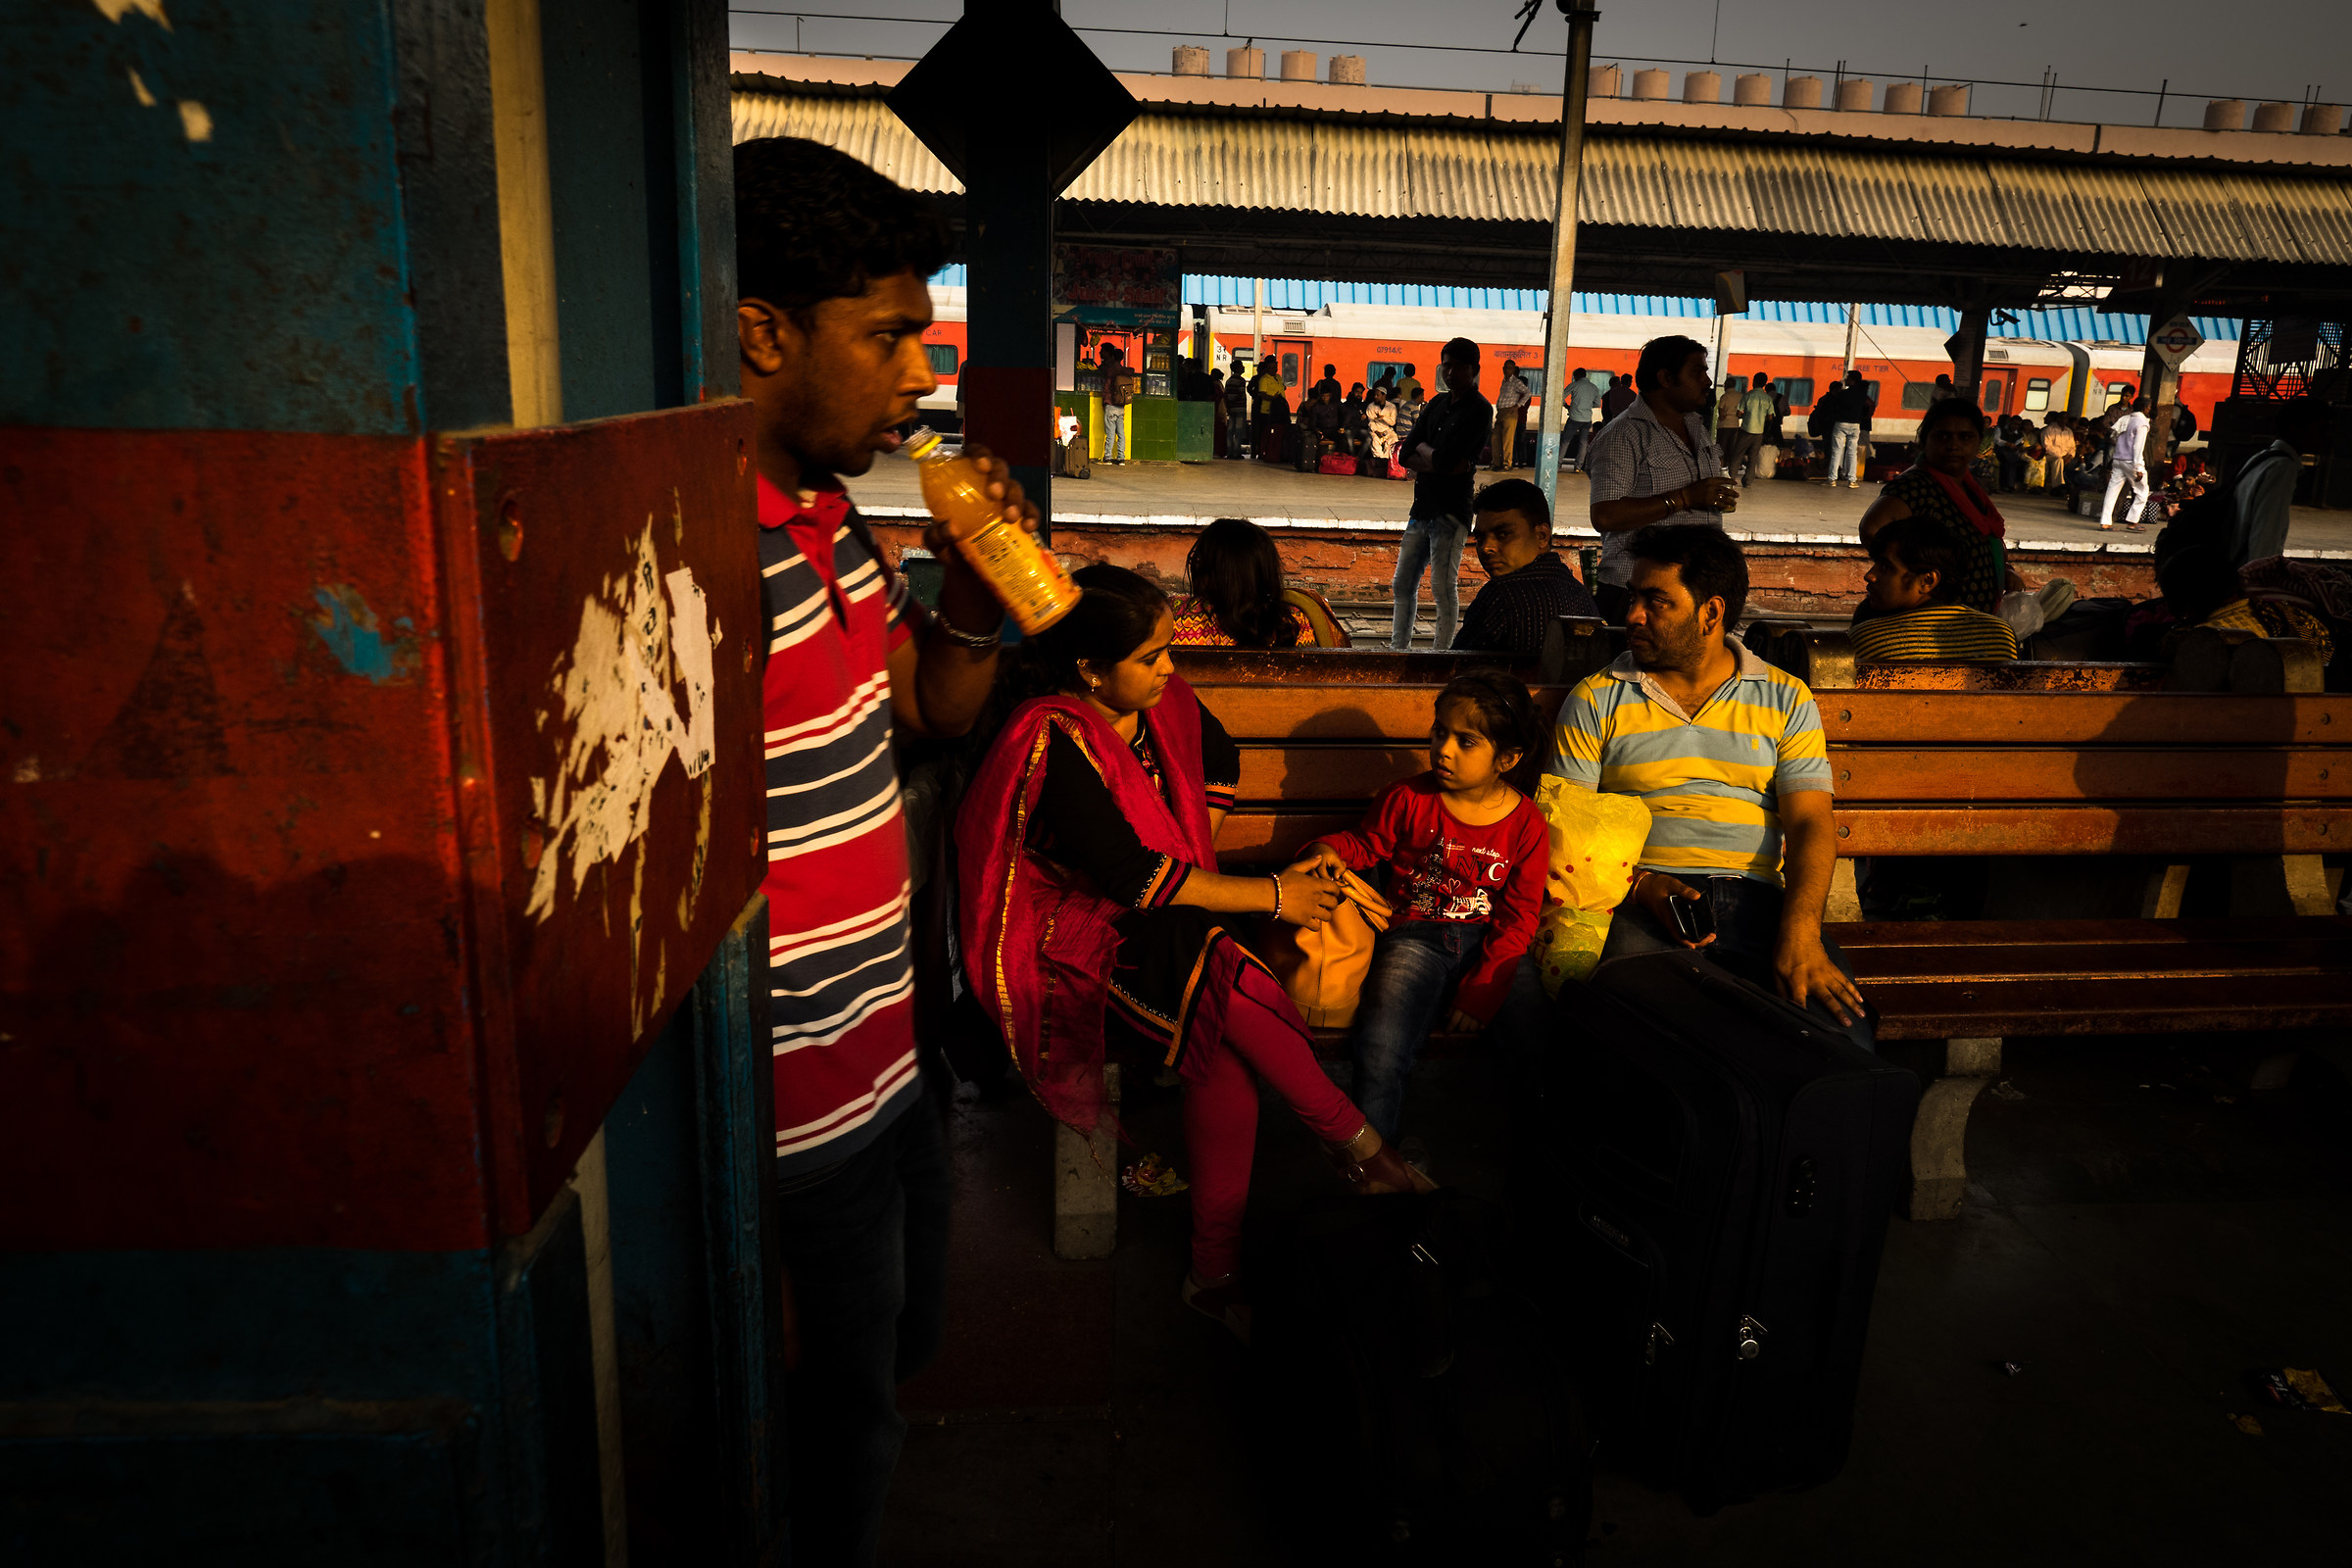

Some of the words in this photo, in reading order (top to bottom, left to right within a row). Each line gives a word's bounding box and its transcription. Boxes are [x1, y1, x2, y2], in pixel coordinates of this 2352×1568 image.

[1067, 283, 1119, 302] Juice
[1122, 286, 1164, 304] Stall
[1455, 855, 1505, 882] NYC
